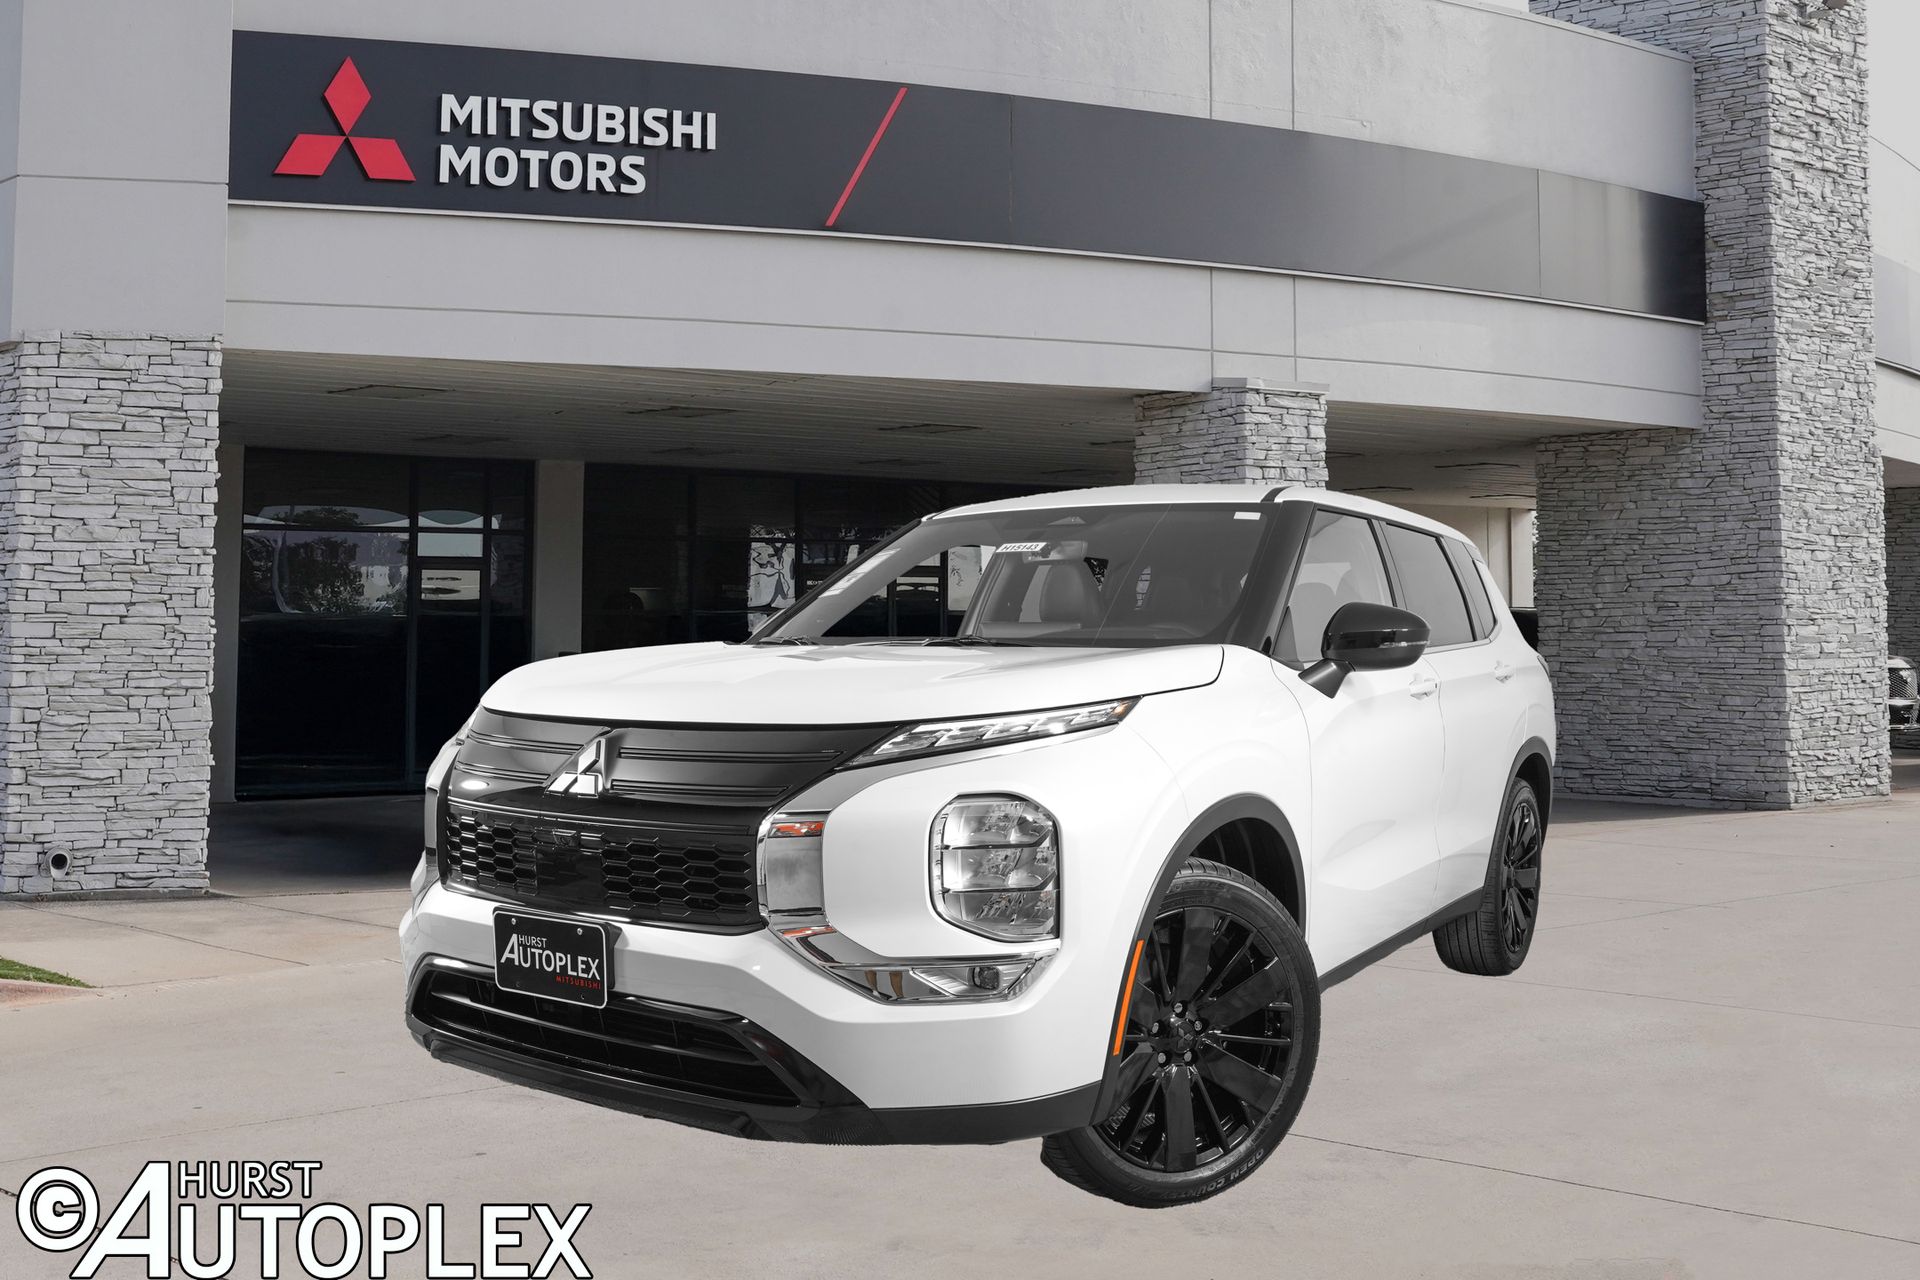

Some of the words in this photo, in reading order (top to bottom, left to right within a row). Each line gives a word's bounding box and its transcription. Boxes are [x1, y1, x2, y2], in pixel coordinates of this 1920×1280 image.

[439, 93, 717, 151] MITSUBISHI
[438, 145, 647, 195] MOTORS
[500, 933, 601, 981] AUTOPLEX
[518, 934, 548, 949] HURST
[555, 975, 601, 990] MITSUBISHI
[1230, 1148, 1264, 1180] OPEN
